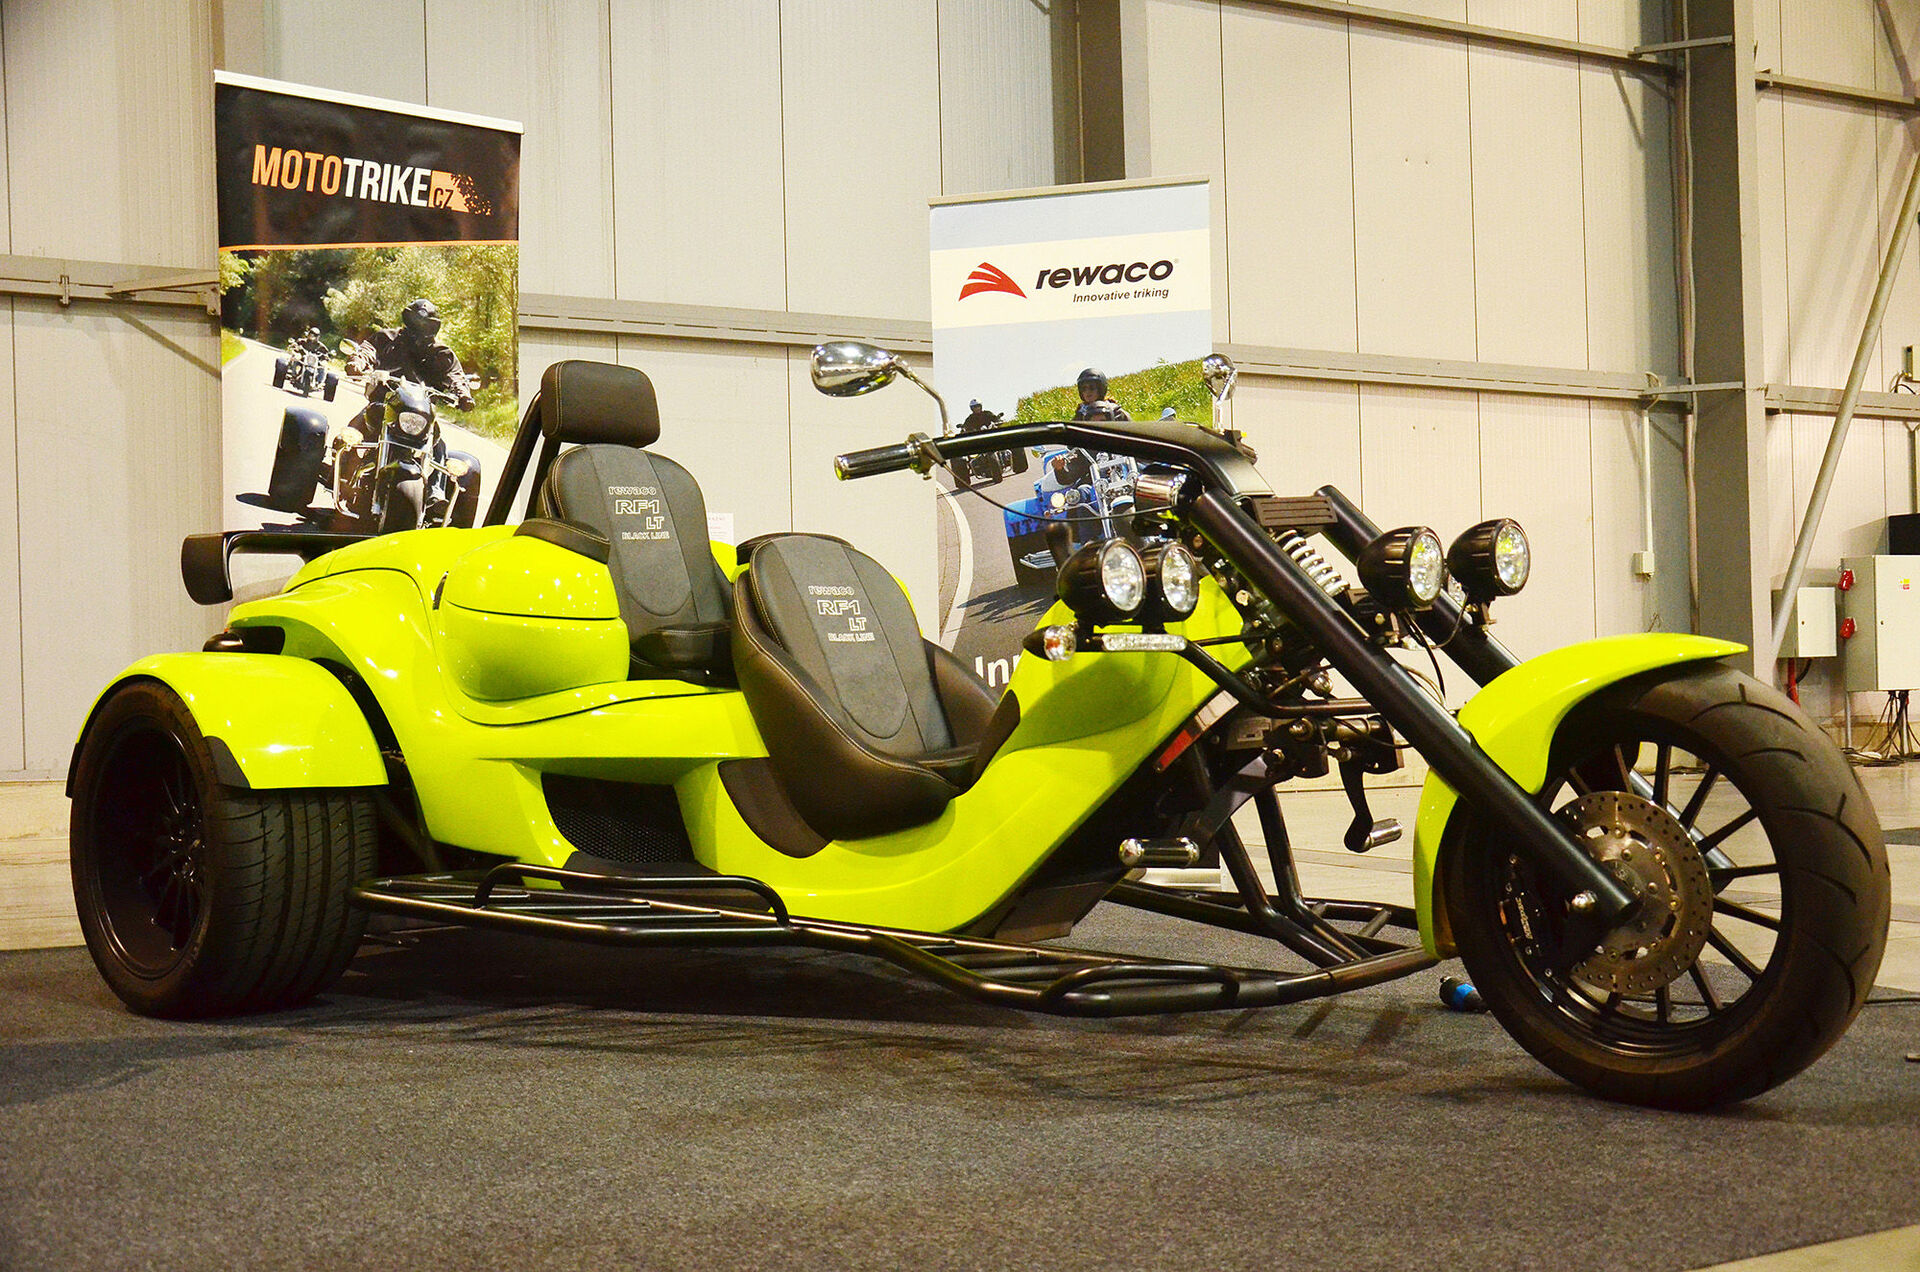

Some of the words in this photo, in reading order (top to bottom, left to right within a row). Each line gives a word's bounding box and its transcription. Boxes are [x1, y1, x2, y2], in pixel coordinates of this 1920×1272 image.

[1036, 259, 1174, 289] rewaco
[1073, 290, 1131, 302] Innovative
[1133, 288, 1170, 299] triking
[608, 486, 657, 496] rewaco
[615, 499, 660, 515] RF1
[645, 516, 665, 530] LT
[621, 531, 651, 540] BLACK
[807, 585, 855, 596] rewaco
[816, 599, 861, 615] RF1
[848, 617, 867, 631] LT
